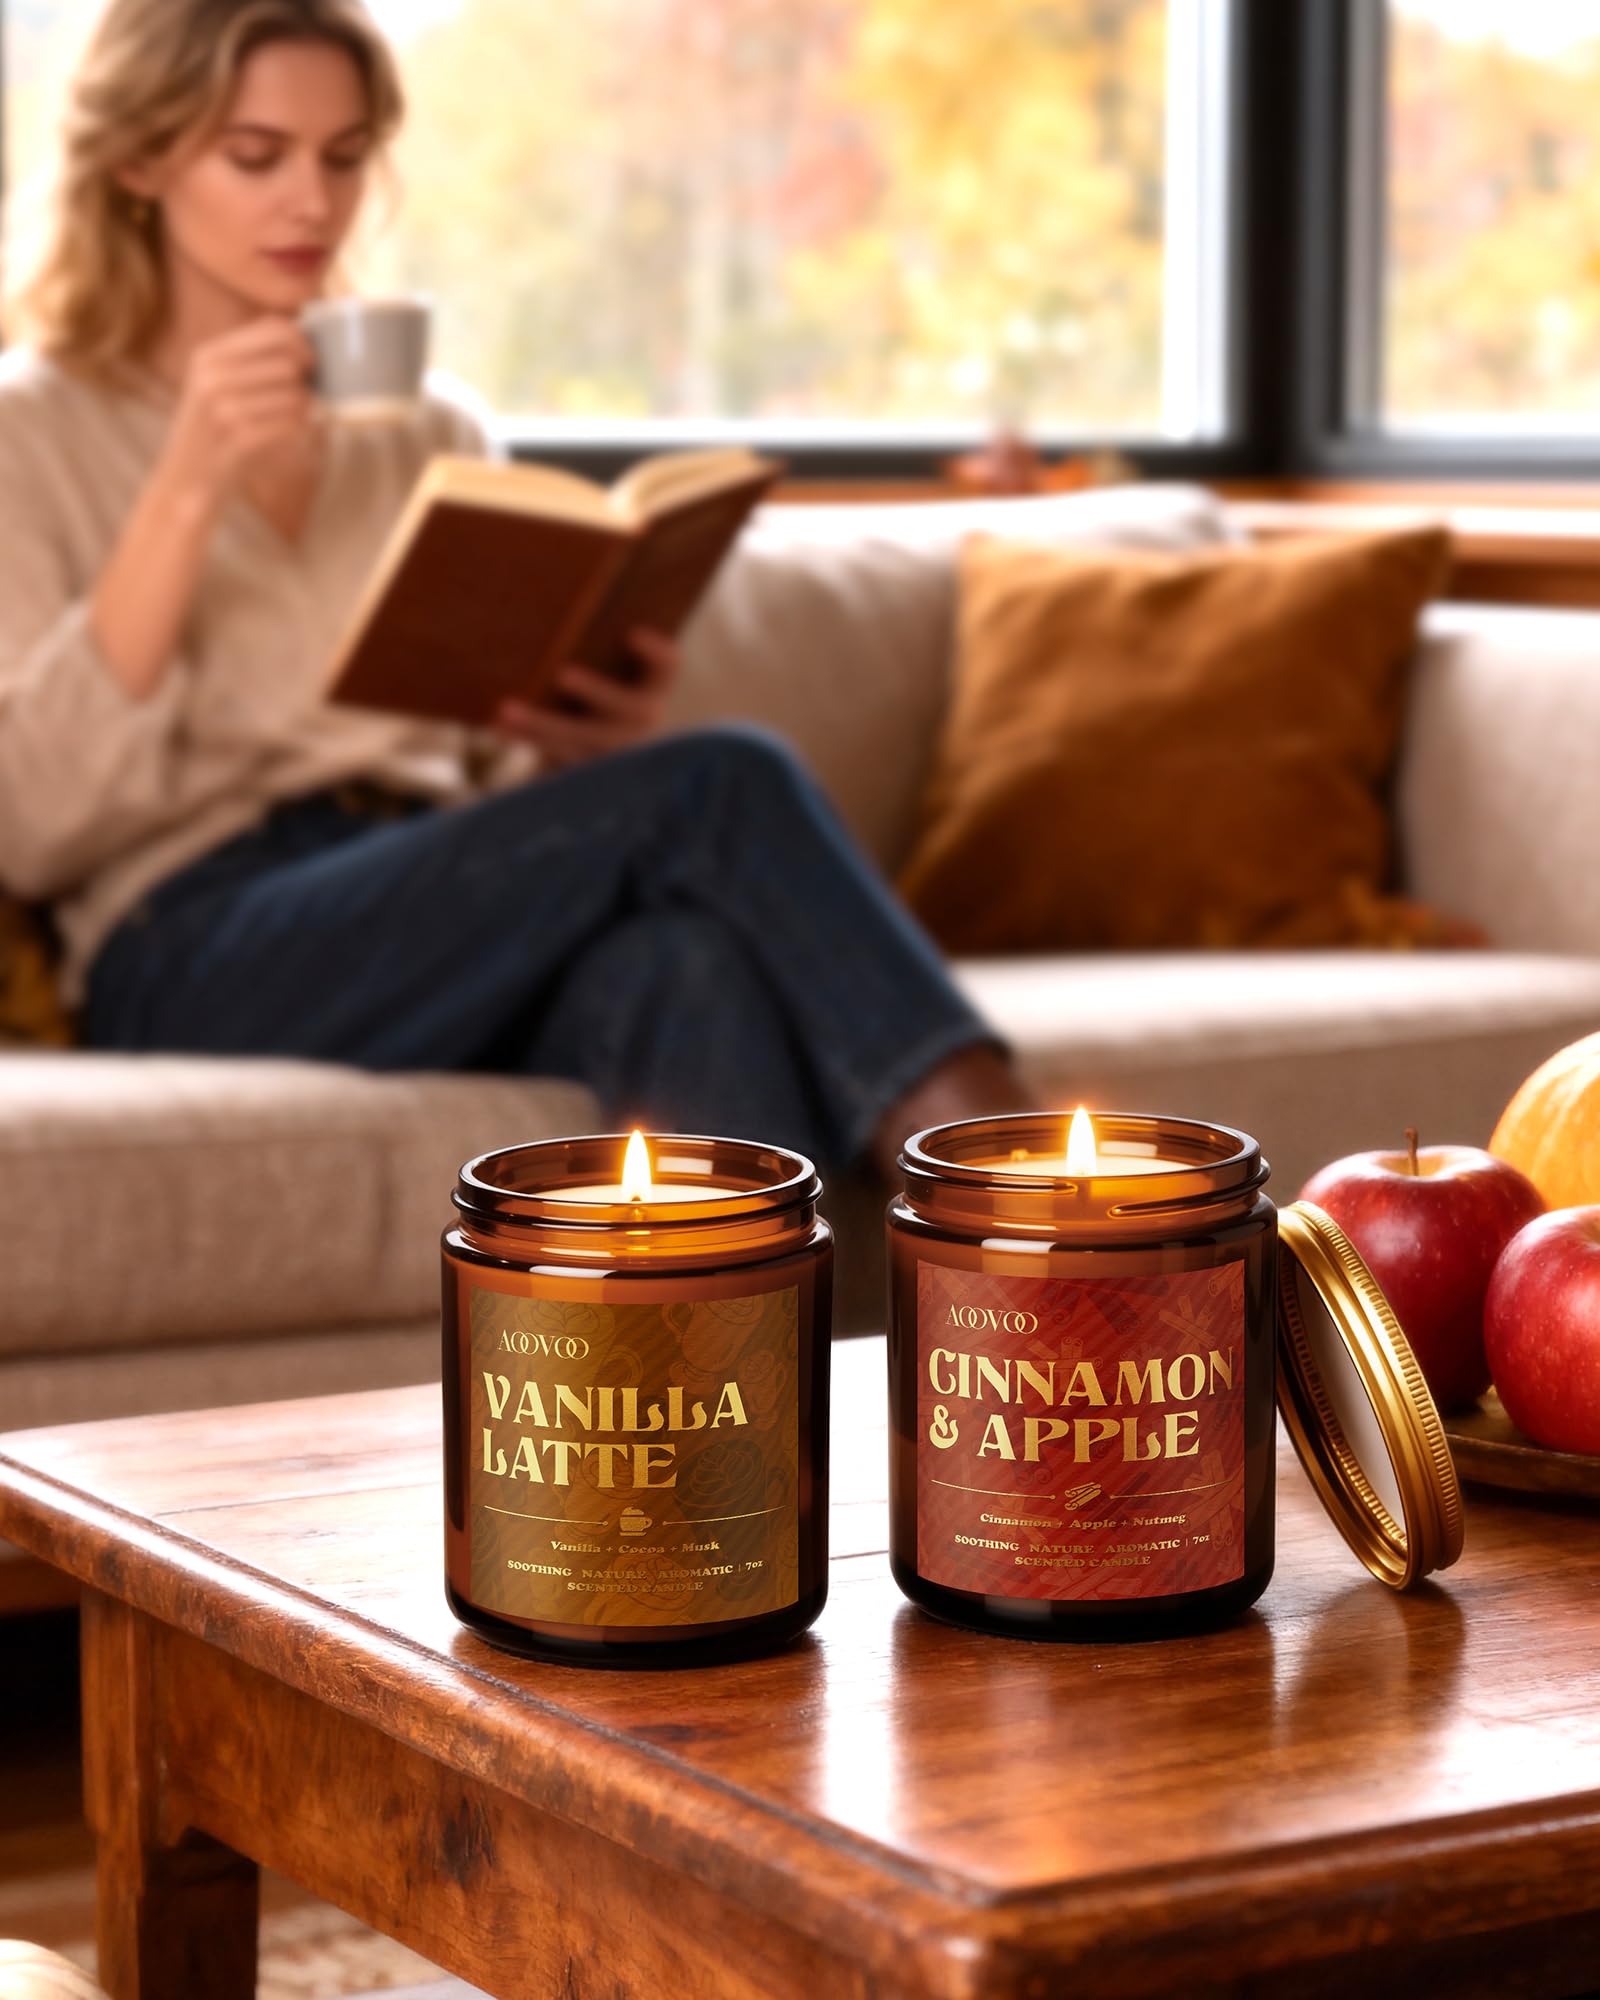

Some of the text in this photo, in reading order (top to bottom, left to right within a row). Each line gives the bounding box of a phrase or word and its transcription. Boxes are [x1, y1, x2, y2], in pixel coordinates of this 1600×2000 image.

[929, 1346, 1233, 1406] CINNAMON
[482, 1371, 749, 1432] VANILLA
[929, 1404, 1199, 1463] & APPLE
[482, 1428, 678, 1489] LATTE
[980, 1513, 1053, 1528] Cinnamon
[1069, 1519, 1117, 1530] Apple
[1133, 1514, 1186, 1526] Nutmeg
[551, 1541, 601, 1553] Vanilla
[618, 1544, 665, 1554] Cocoa
[682, 1541, 720, 1552] Musk
[954, 1534, 1020, 1551] SOOTHING
[1029, 1544, 1095, 1554] NATURE
[1105, 1539, 1181, 1554] AROMATIC
[507, 1560, 573, 1577] SOOTHING
[581, 1569, 648, 1579] NATURE
[658, 1565, 734, 1579] AROMATIC
[1014, 1556, 1151, 1568] SCENTED CANDLE
[567, 1582, 704, 1593] SCENTED CANDLE
